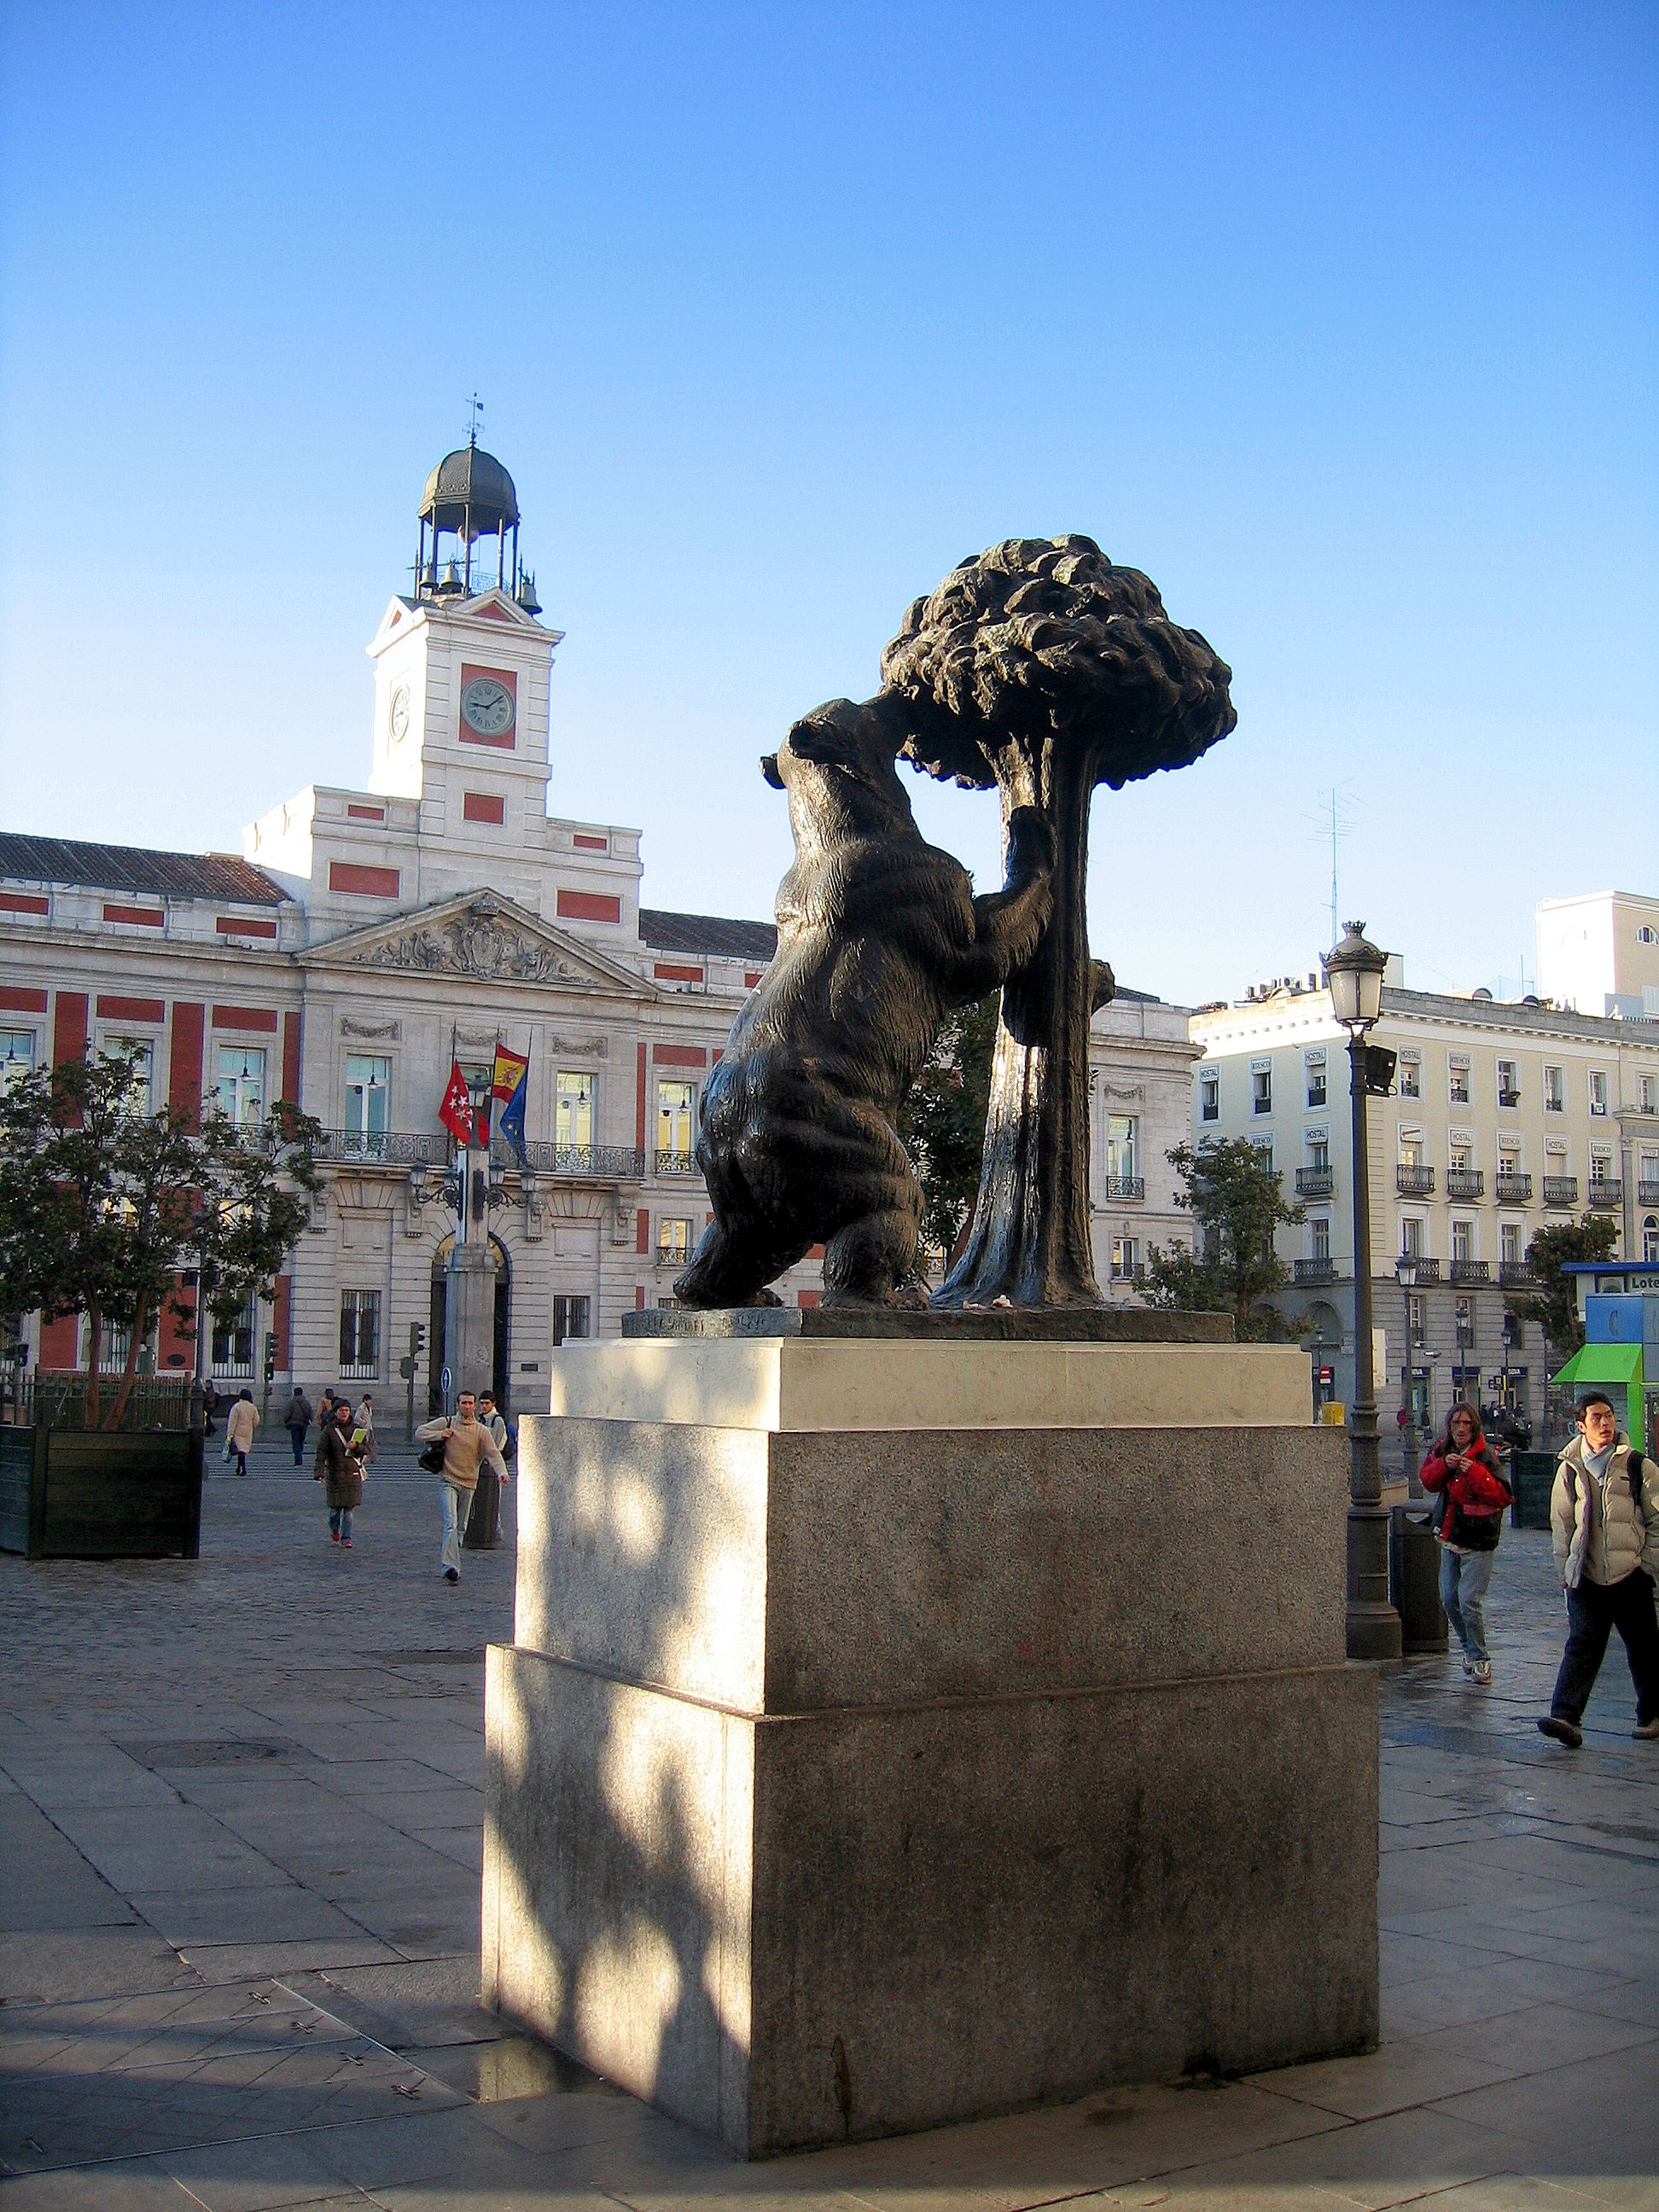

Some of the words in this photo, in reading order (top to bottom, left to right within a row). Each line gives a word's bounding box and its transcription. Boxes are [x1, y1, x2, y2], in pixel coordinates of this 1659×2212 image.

[1306, 1051, 1324, 1061] HOSTAL
[1307, 1129, 1325, 1138] HOSTAL
[1632, 1277, 1659, 1289] Lote
